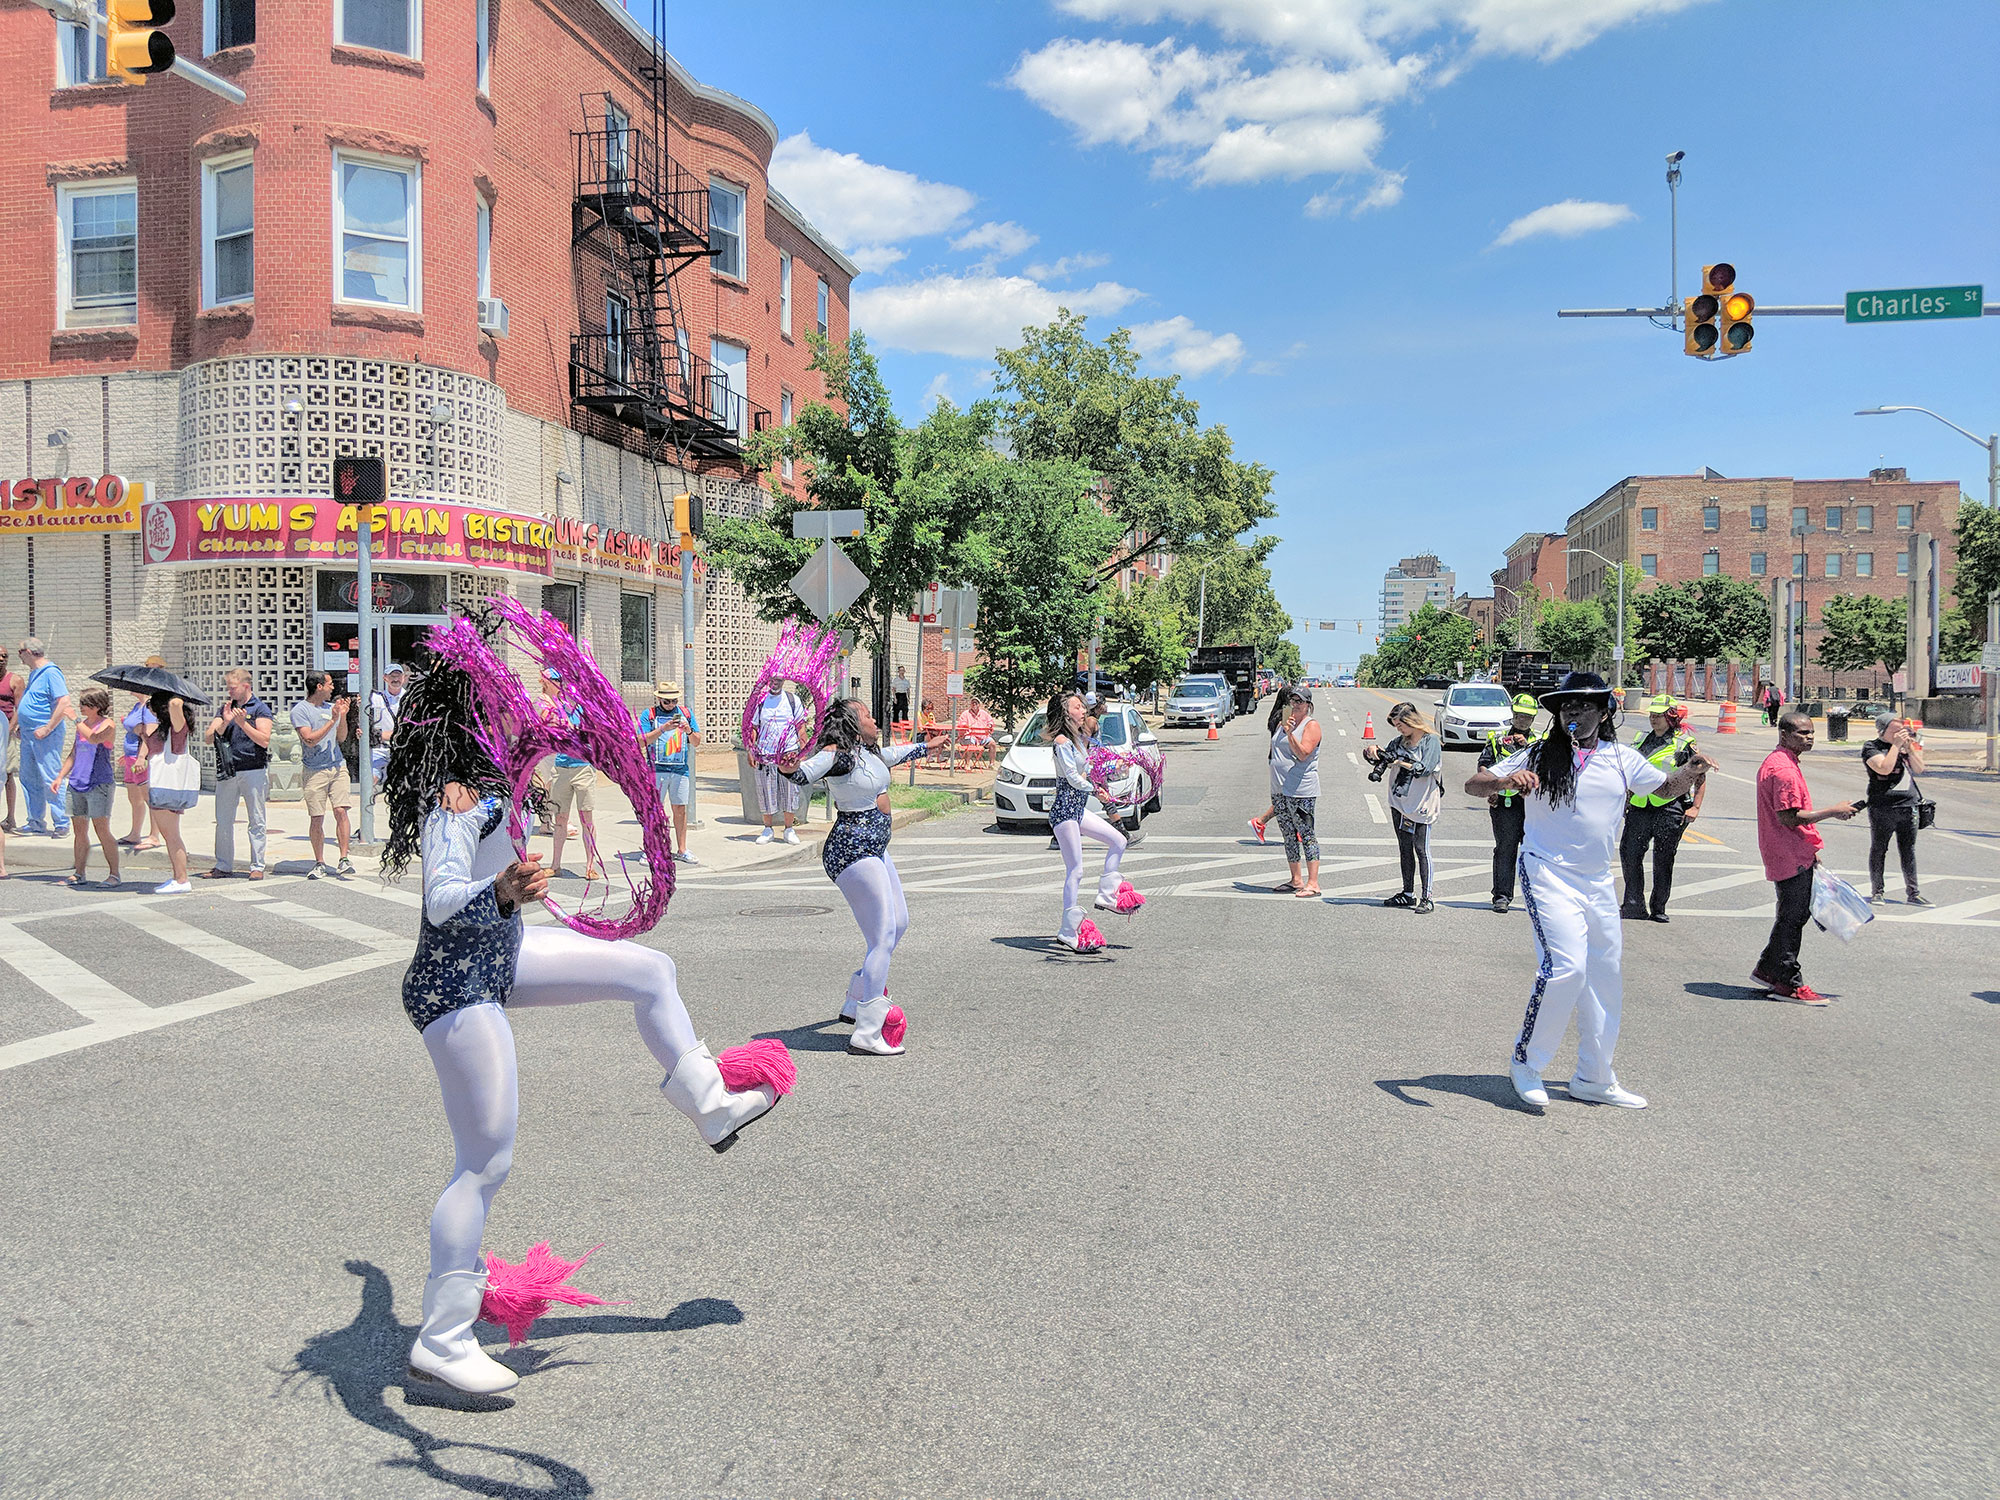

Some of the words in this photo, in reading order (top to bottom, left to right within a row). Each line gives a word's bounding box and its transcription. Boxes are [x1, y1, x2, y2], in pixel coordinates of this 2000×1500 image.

[1857, 294, 1945, 316] Charles
[1964, 290, 1977, 301] St
[0, 474, 126, 511] ISTRO
[0, 511, 134, 527] Restaurant
[336, 505, 450, 536] ASIAN
[466, 513, 555, 550] BISTRO
[199, 537, 285, 552] Chinese
[294, 538, 386, 555] Seafod
[400, 540, 463, 556] Sushi
[469, 545, 548, 568] Restaurant
[543, 513, 583, 546] UM
[605, 528, 651, 560] ASIAN
[657, 541, 708, 574] BISRO
[581, 553, 620, 569] Seafood
[624, 561, 652, 576] Sushi
[1939, 668, 1971, 684] SAFEWAY
